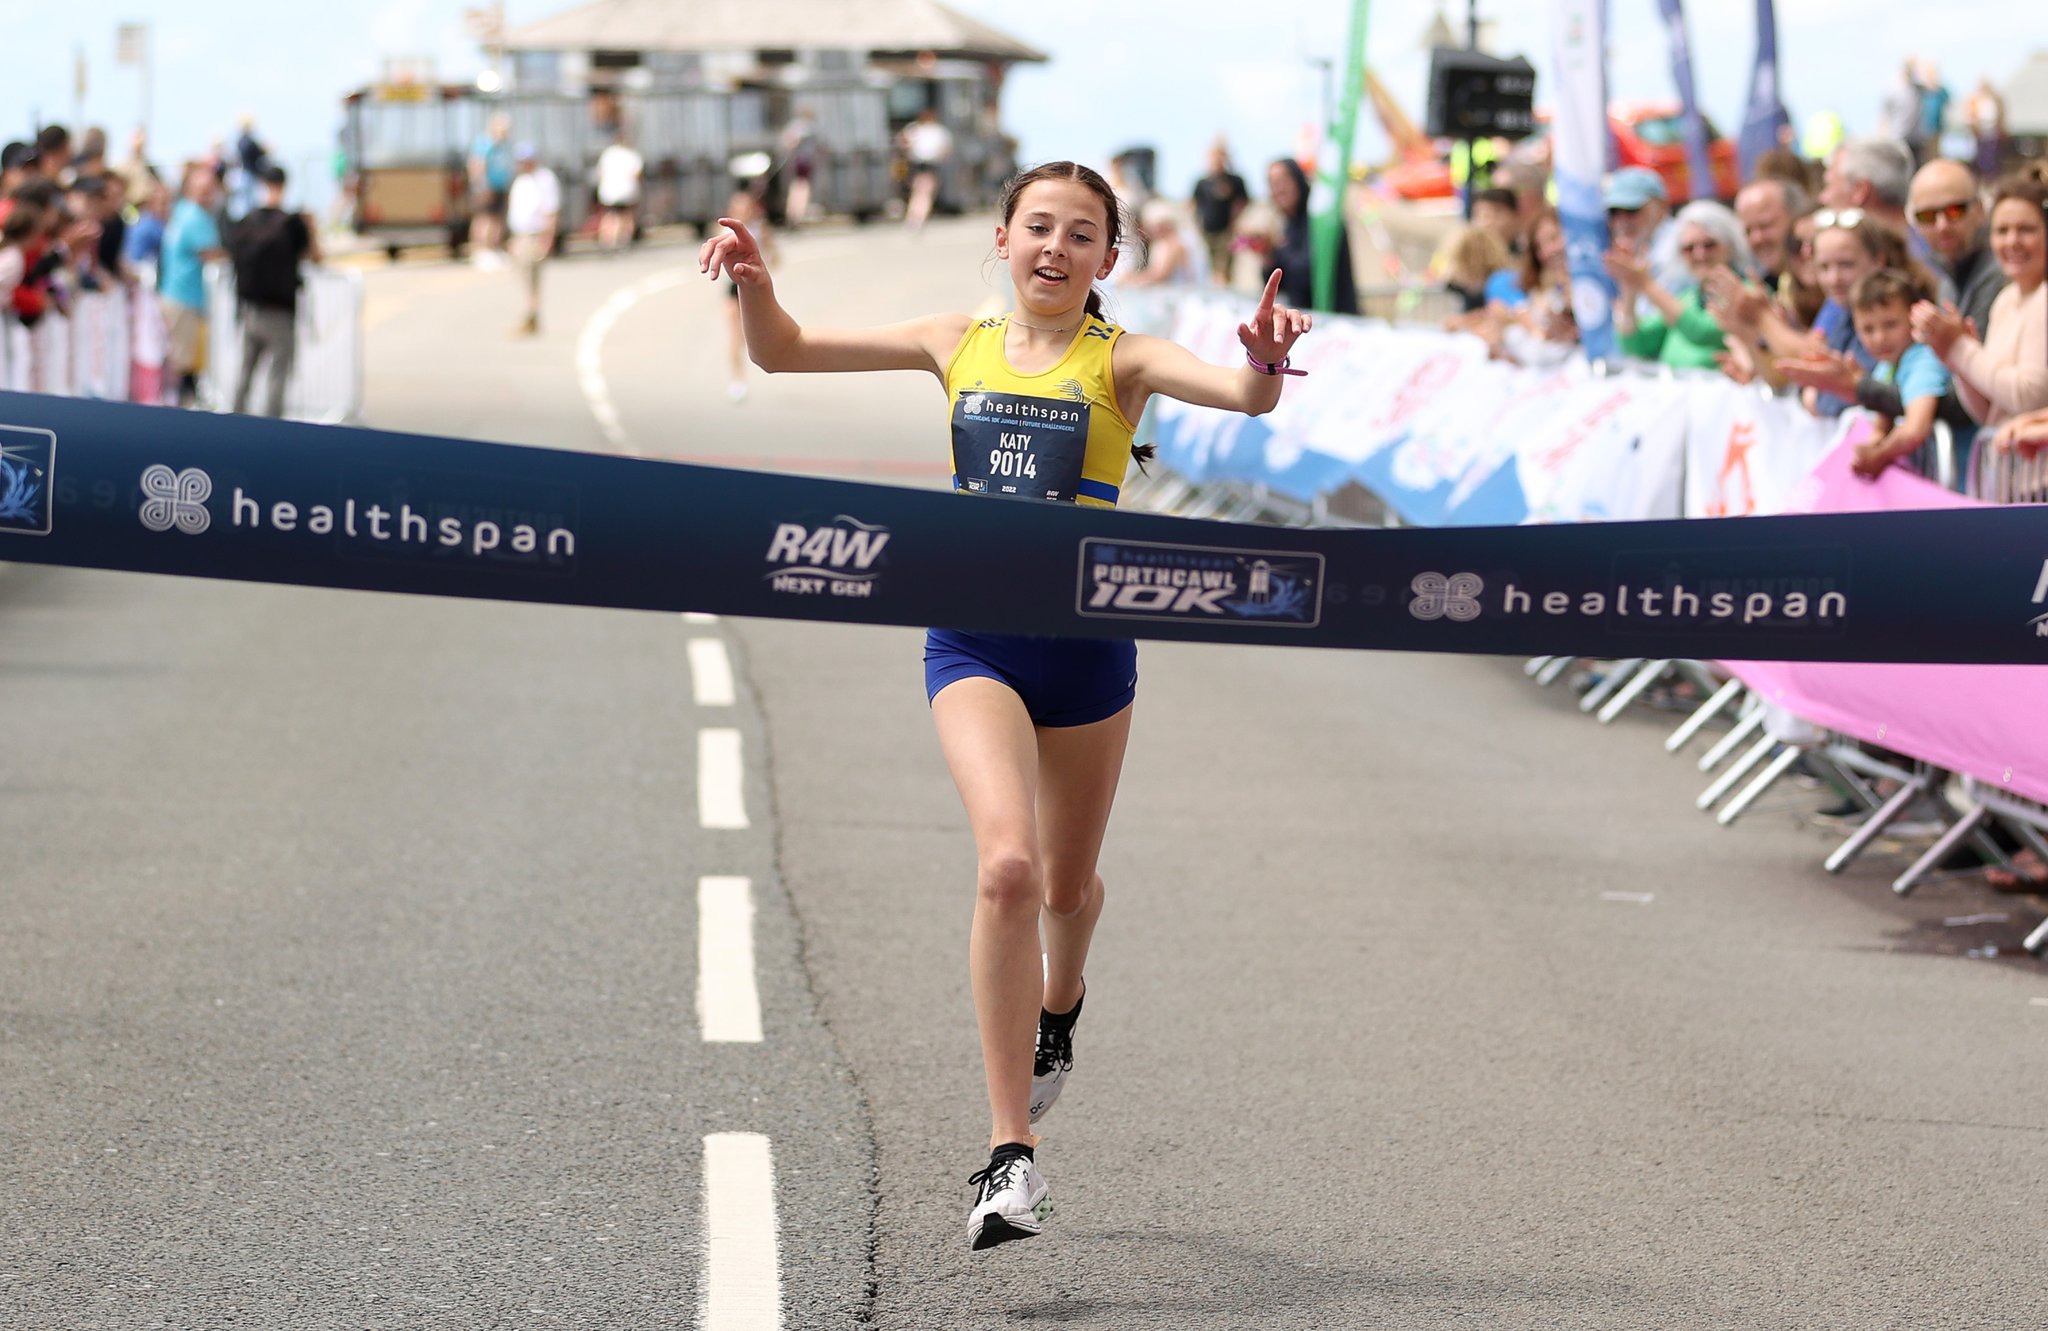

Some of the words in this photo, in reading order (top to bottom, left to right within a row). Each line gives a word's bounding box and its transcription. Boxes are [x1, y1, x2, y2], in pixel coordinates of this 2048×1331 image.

[986, 399, 1079, 421] healthspan
[1022, 420, 1041, 428] FUTURE
[1041, 423, 1075, 432] CHALLENGERS
[1000, 432, 1031, 451] KATY
[990, 449, 1037, 479] 9014
[1001, 485, 1017, 493] 2022
[233, 487, 575, 555] healthspan
[766, 522, 890, 569] R4W
[773, 575, 826, 594] NEXT
[830, 580, 872, 597] GEN
[1093, 563, 1237, 591] PORTHCAWL
[1088, 581, 1237, 614] 10K
[1504, 584, 1846, 623] healthspan
